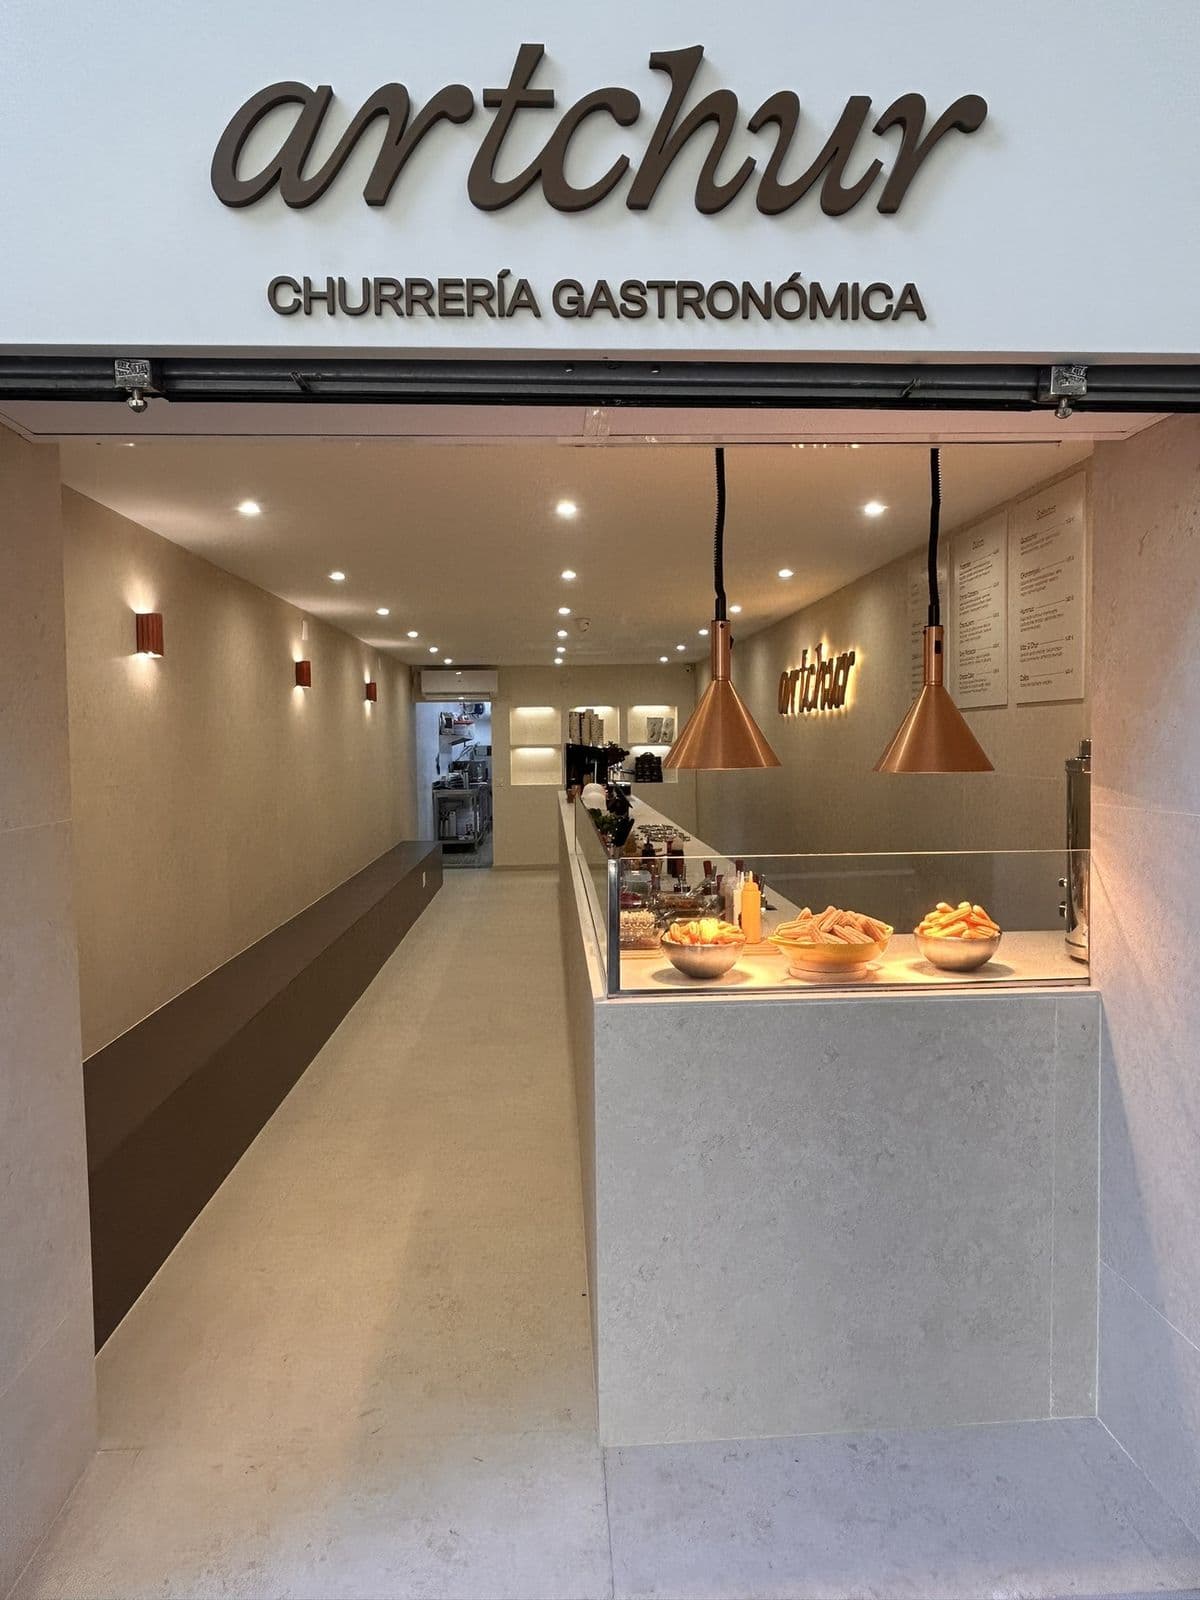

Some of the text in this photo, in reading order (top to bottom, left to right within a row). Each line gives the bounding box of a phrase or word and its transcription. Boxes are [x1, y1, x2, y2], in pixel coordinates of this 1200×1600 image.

[211, 44, 988, 216] artchur
[268, 269, 927, 321] CHURRERÍA GASTRONÓMICA
